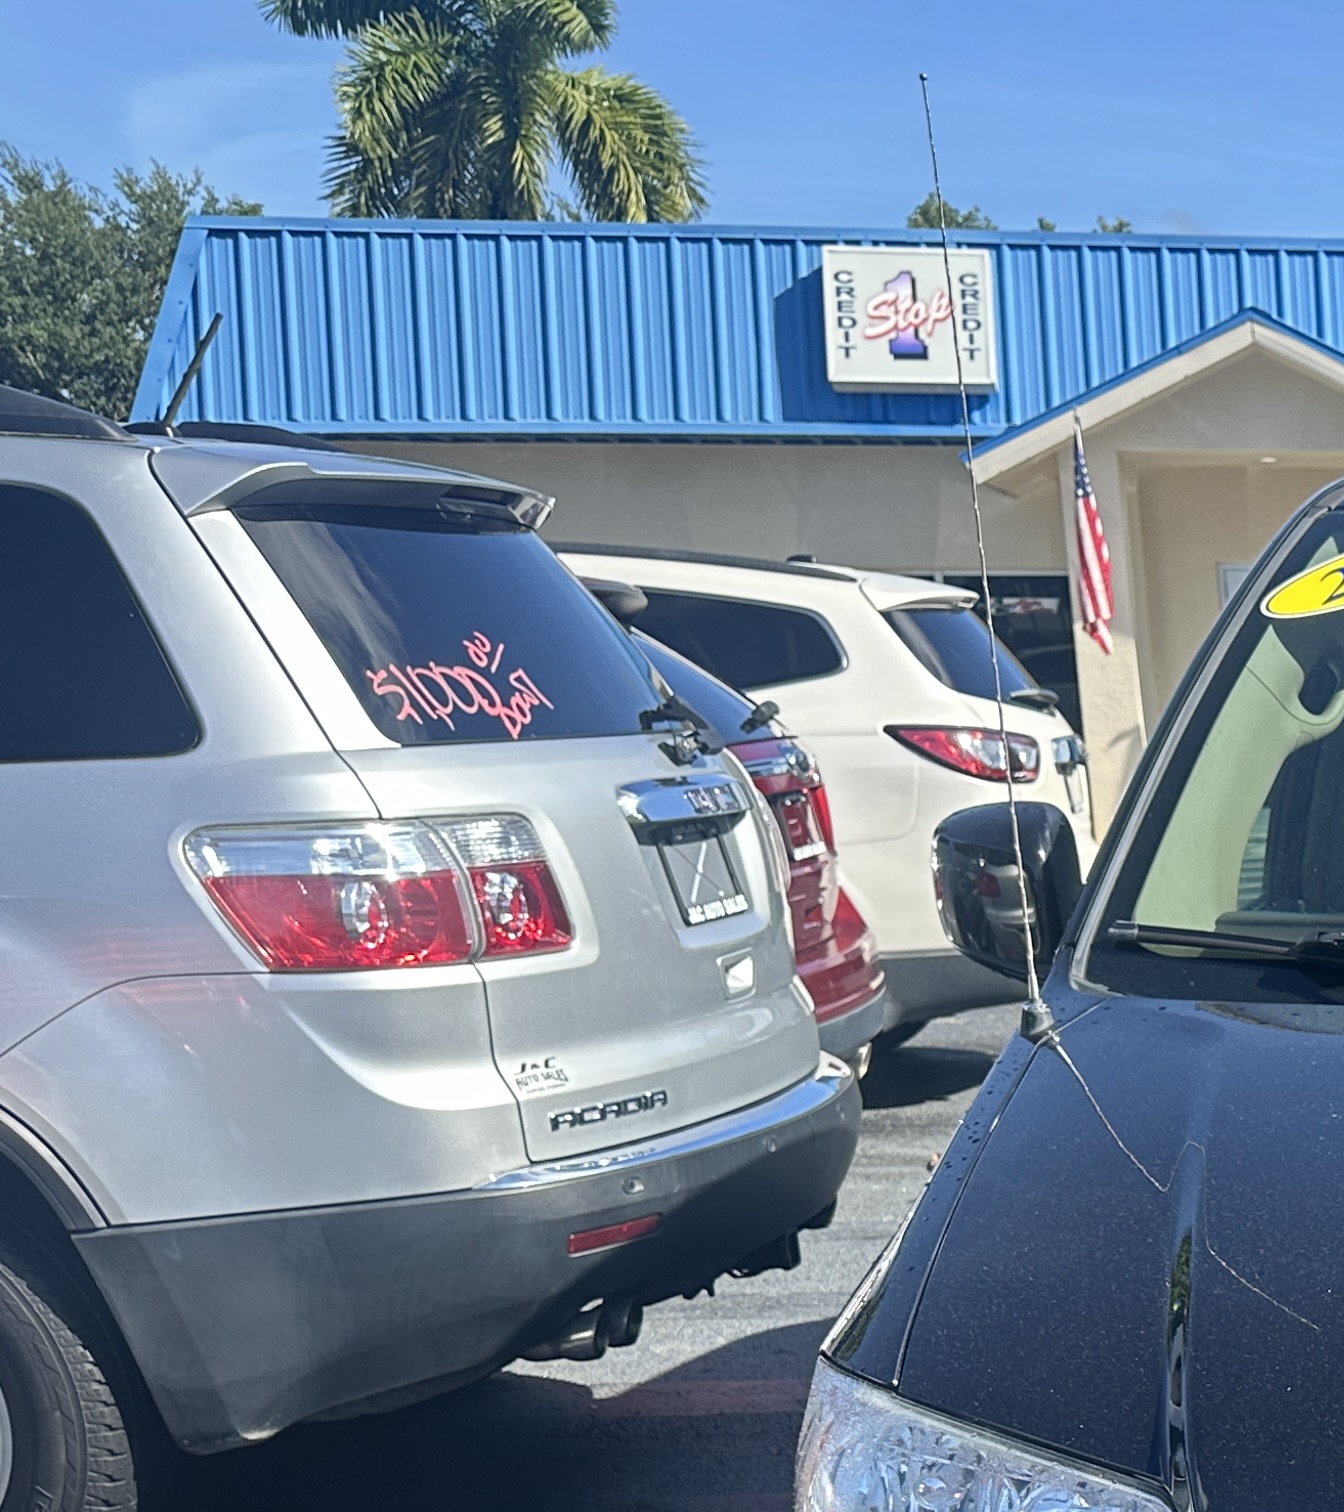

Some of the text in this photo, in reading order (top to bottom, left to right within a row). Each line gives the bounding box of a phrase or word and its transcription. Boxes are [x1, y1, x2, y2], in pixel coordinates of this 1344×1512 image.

[833, 271, 857, 359] CREDIT
[864, 288, 954, 340] Stop
[959, 273, 982, 361] CREDIT
[547, 1088, 669, 1132] ACADIA
